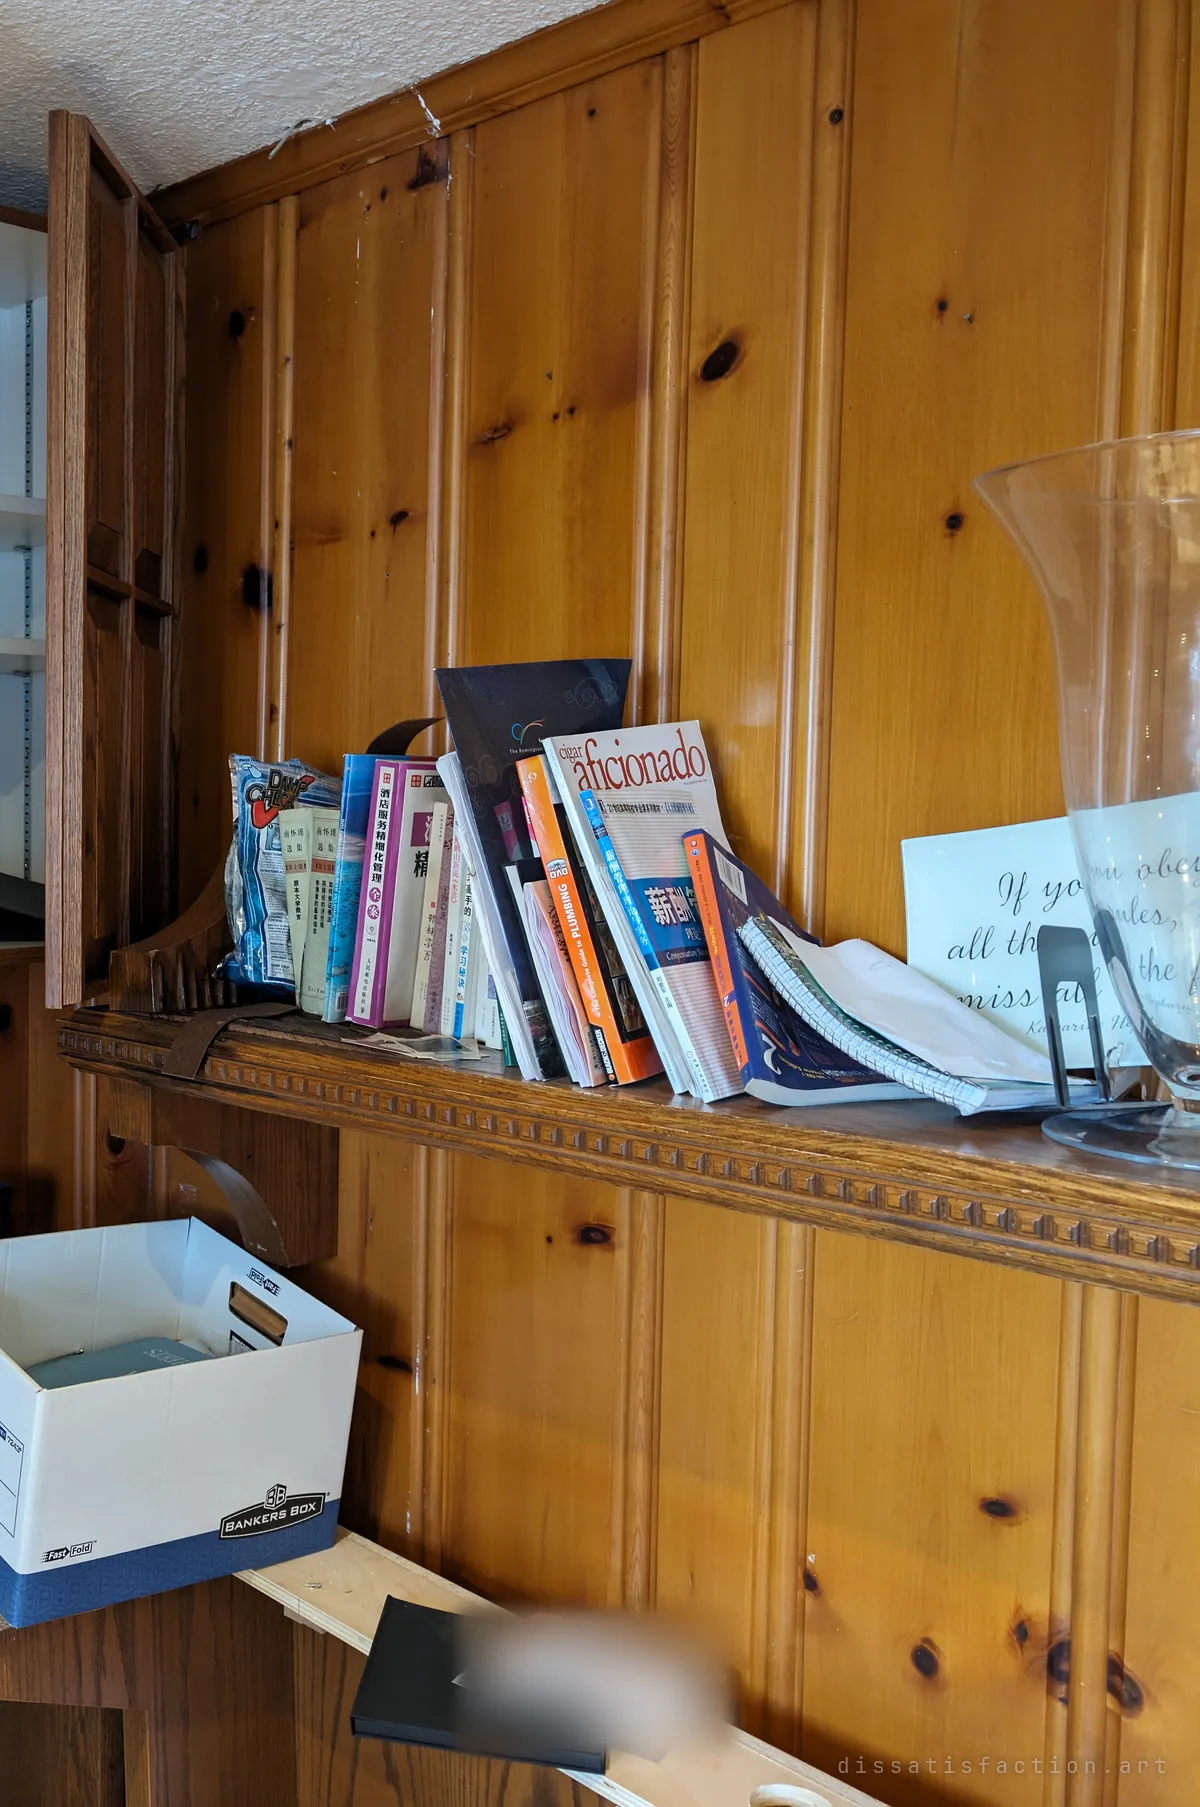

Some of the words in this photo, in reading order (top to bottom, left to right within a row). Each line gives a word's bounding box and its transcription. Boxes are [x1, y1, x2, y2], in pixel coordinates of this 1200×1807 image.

[559, 744, 583, 763] cigar
[573, 728, 706, 791] aficionado
[268, 768, 308, 792] DAMP
[549, 867, 568, 879] DVD
[999, 871, 1029, 915] If
[1042, 879, 1085, 913] yo
[556, 882, 582, 940] PLUMBING
[575, 940, 584, 949] to
[948, 925, 996, 960] all
[1007, 922, 1038, 956] th
[458, 946, 468, 988] 学习秘诀
[577, 948, 588, 968] Guide
[1139, 948, 1178, 982] the
[580, 967, 597, 1000] Complete
[957, 984, 1039, 1010] miss
[225, 1510, 287, 1532] BANKERS
[290, 1502, 316, 1518] BOX
[48, 1548, 67, 1560] Fast
[71, 1543, 90, 1556] Fold
